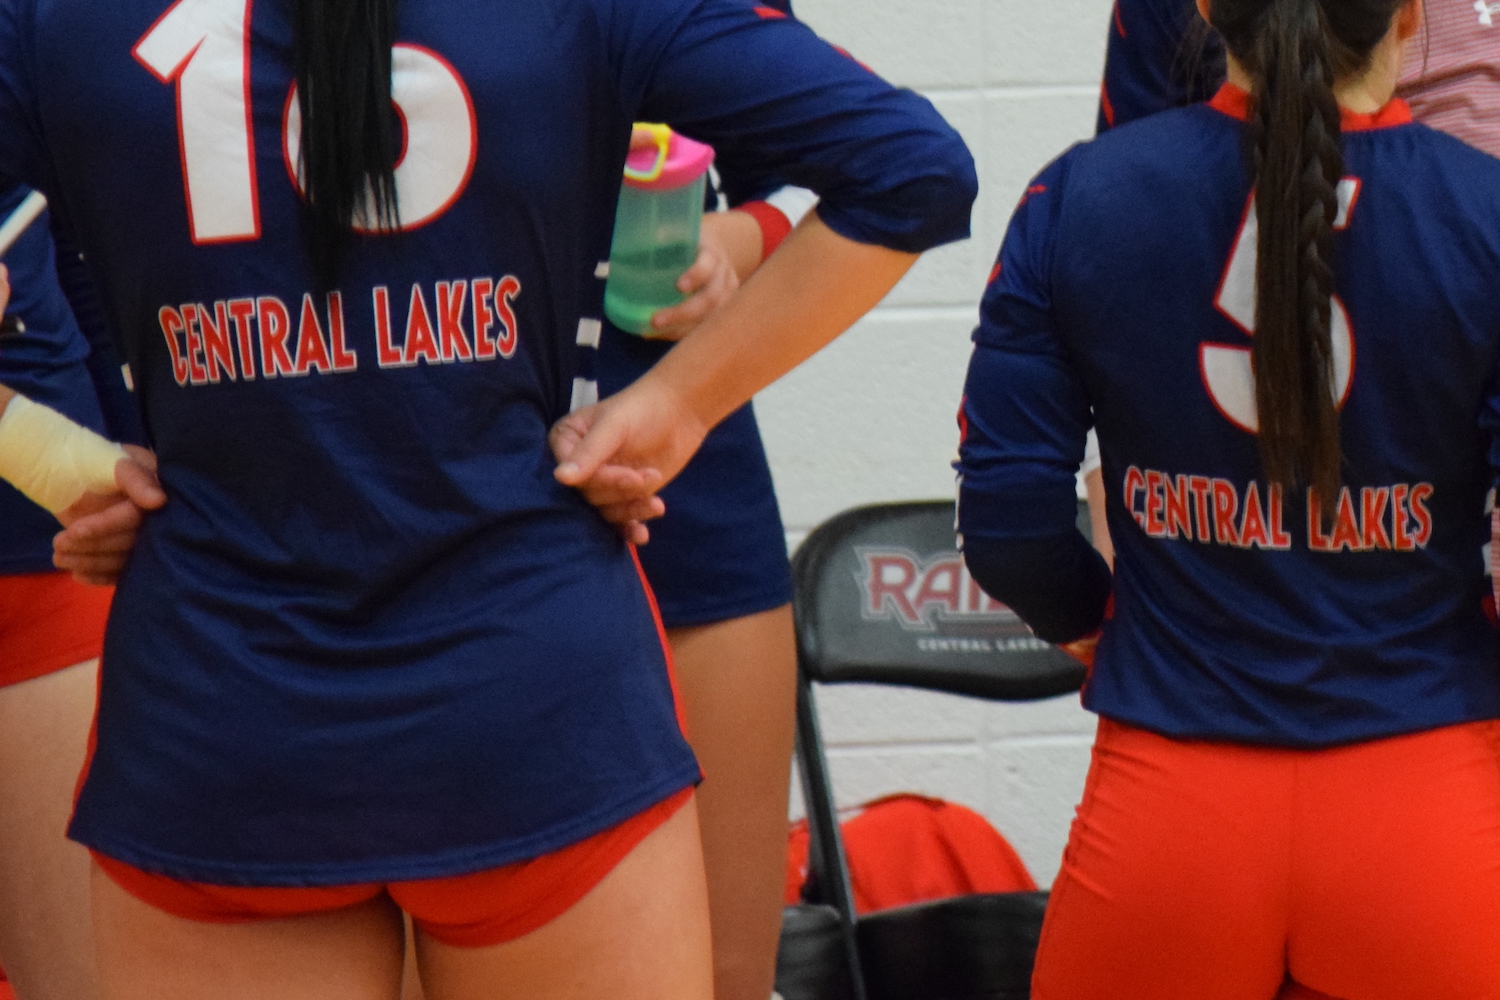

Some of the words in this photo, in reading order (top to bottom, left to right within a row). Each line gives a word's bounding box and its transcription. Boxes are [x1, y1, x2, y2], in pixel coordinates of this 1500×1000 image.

[158, 291, 358, 388] CENTRAL
[372, 275, 522, 366] LAKES
[1124, 465, 1291, 551] CENTRAL
[1307, 482, 1434, 552] LAKES
